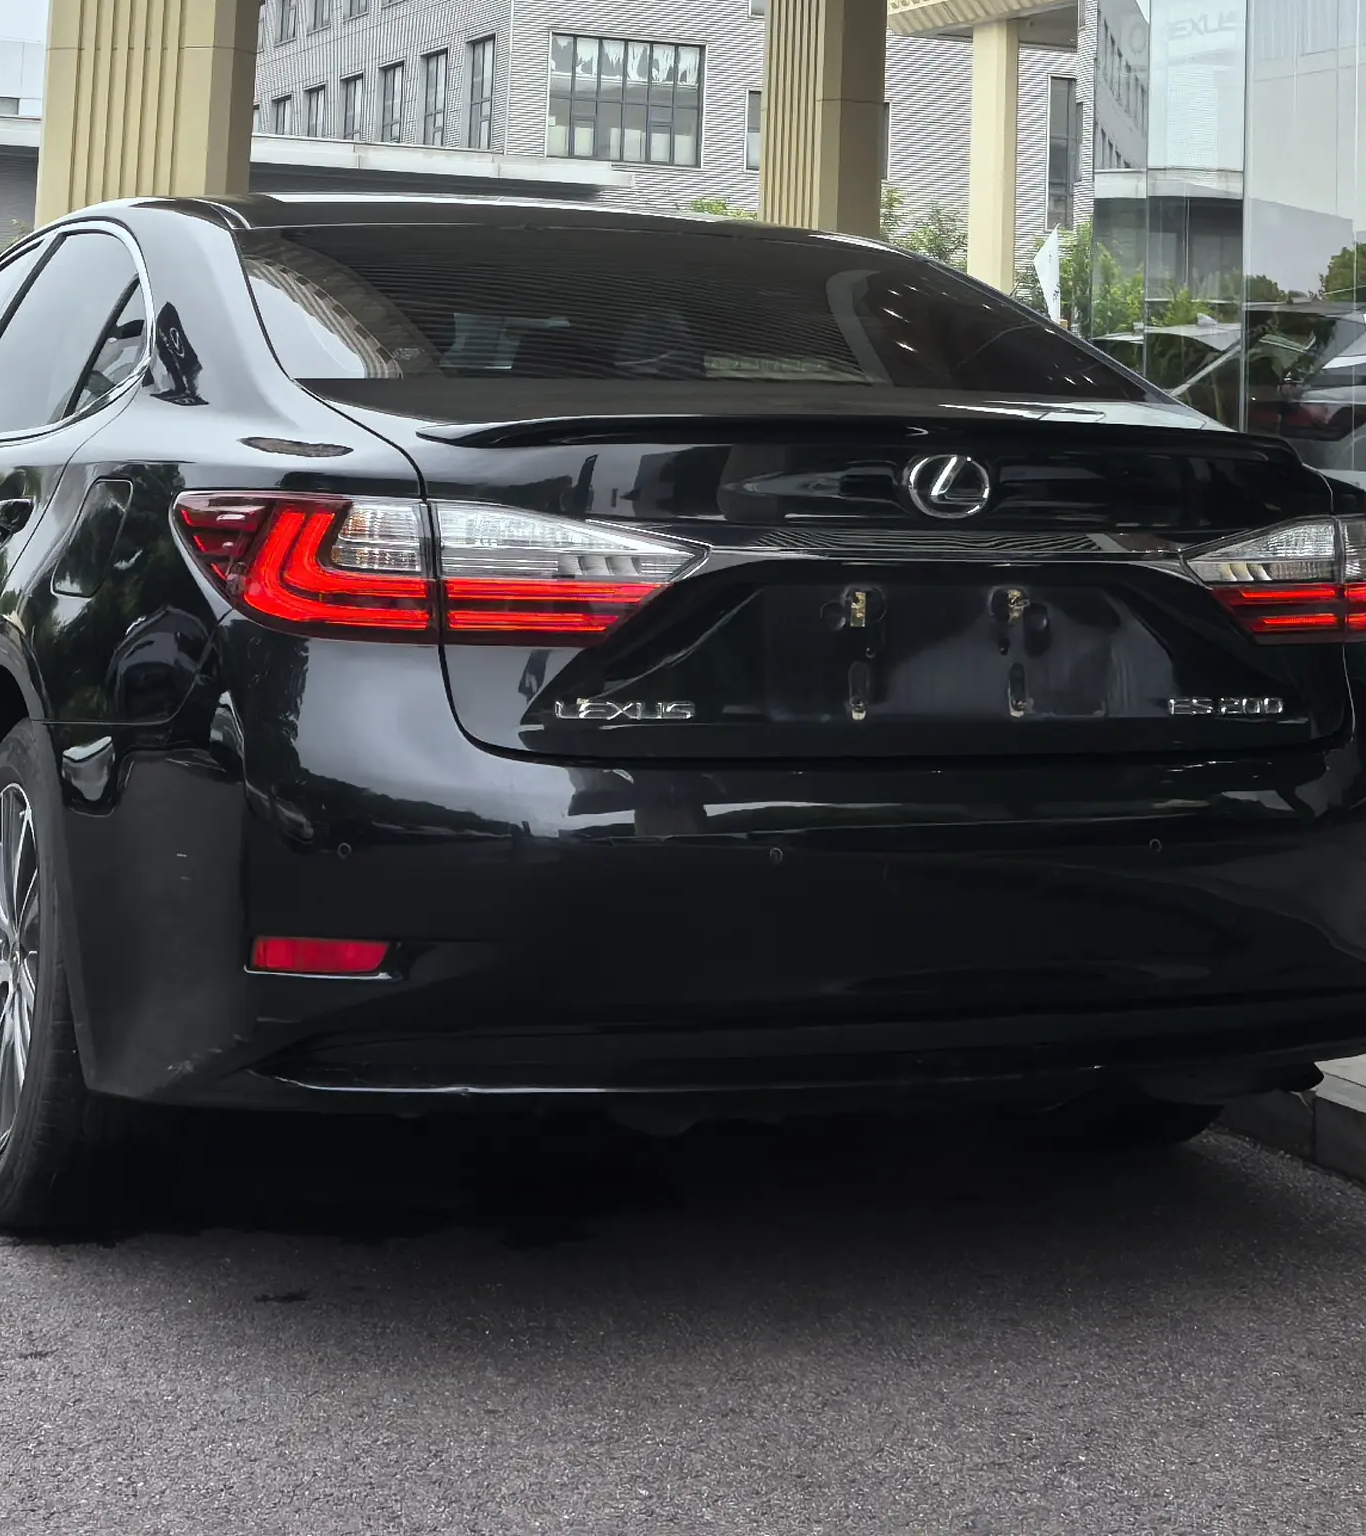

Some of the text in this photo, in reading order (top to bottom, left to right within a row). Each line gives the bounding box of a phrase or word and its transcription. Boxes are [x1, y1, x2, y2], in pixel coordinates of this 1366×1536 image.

[553, 700, 696, 720] LEXUS
[1169, 697, 1285, 715] ES 200
